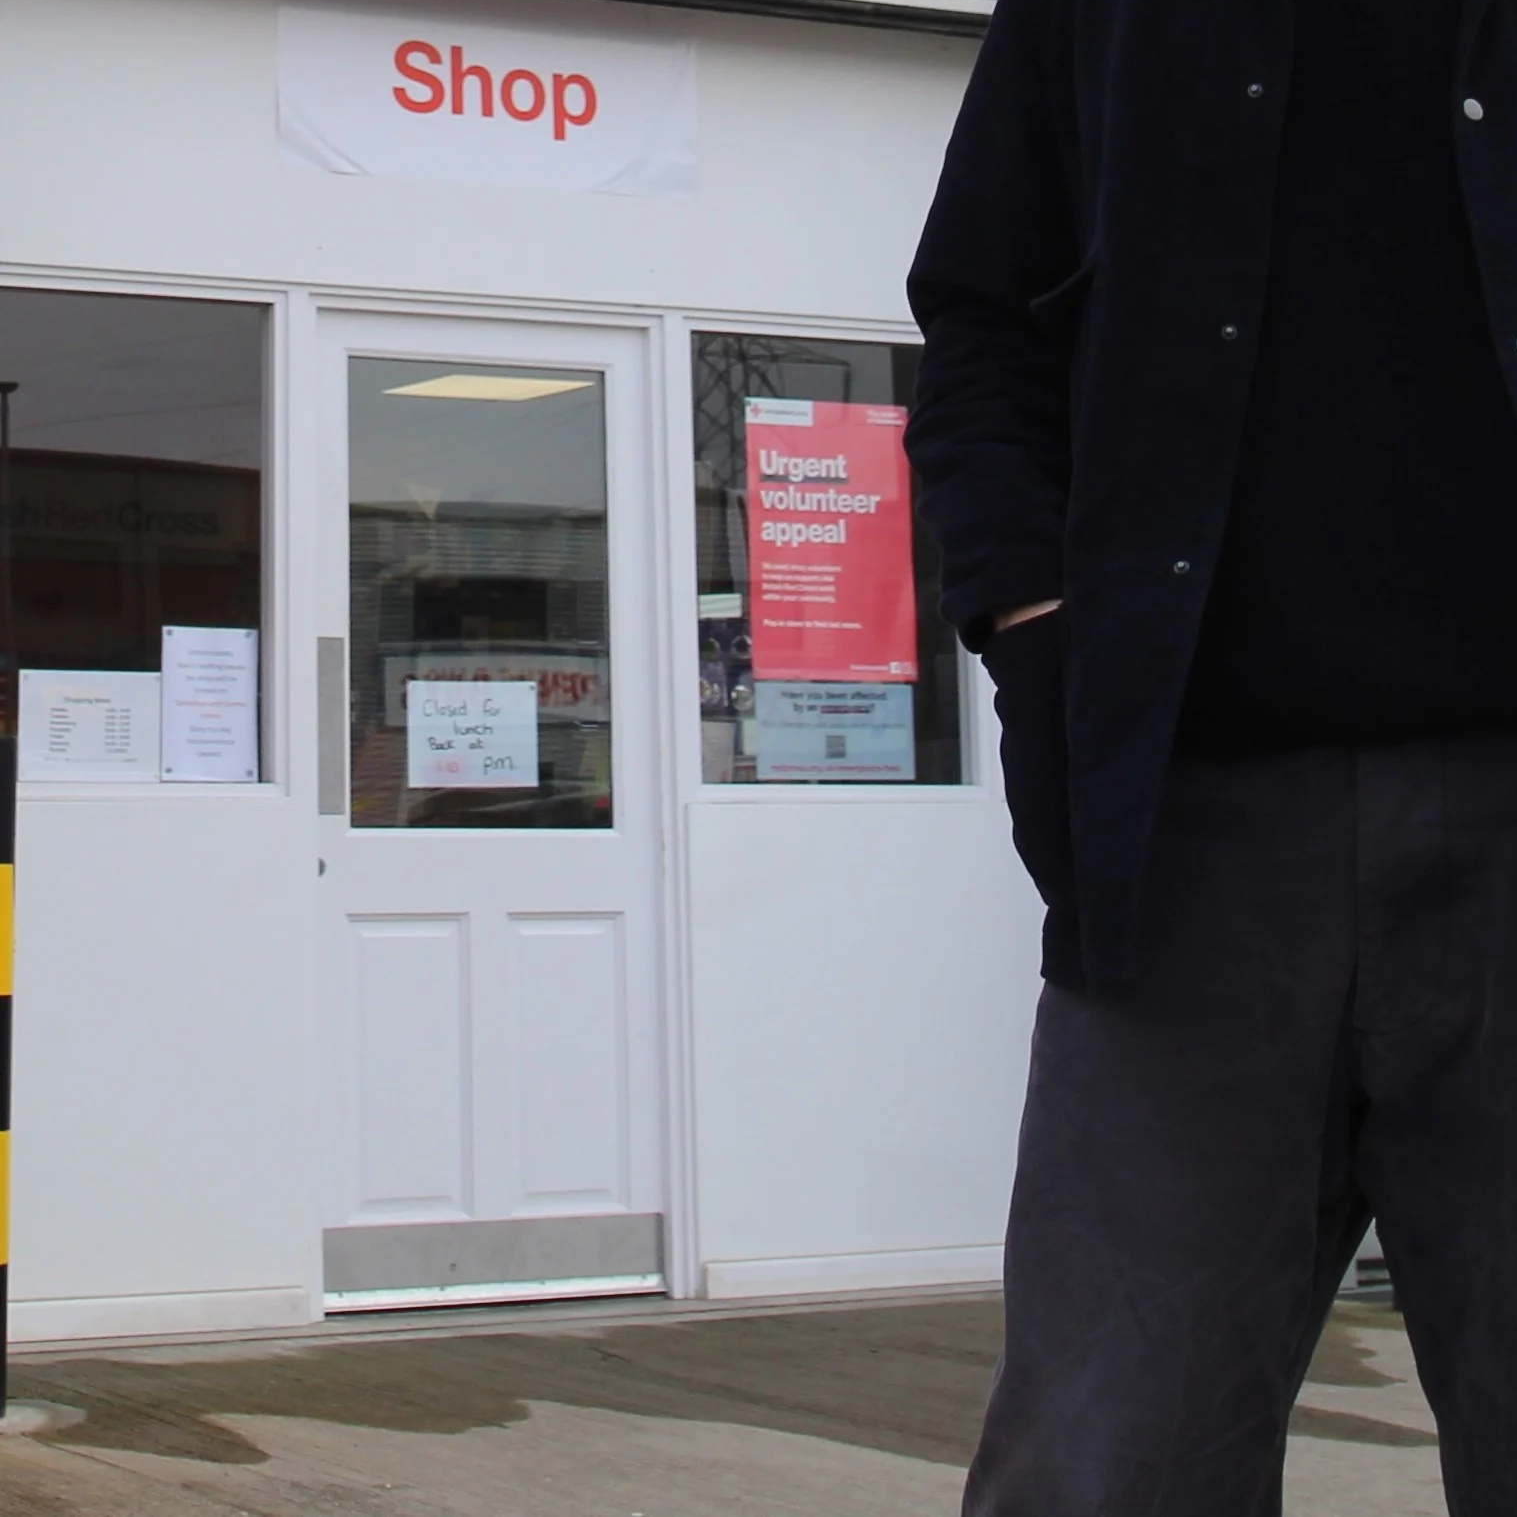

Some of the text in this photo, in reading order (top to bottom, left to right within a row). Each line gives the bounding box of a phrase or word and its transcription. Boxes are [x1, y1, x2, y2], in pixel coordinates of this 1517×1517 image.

[393, 40, 597, 141] Shop
[759, 449, 848, 482] Urgent
[760, 485, 881, 514] volunteer
[761, 518, 846, 548] appeal
[423, 698, 502, 717] Closed for
[453, 719, 494, 736] lunch
[427, 736, 484, 751] Back at
